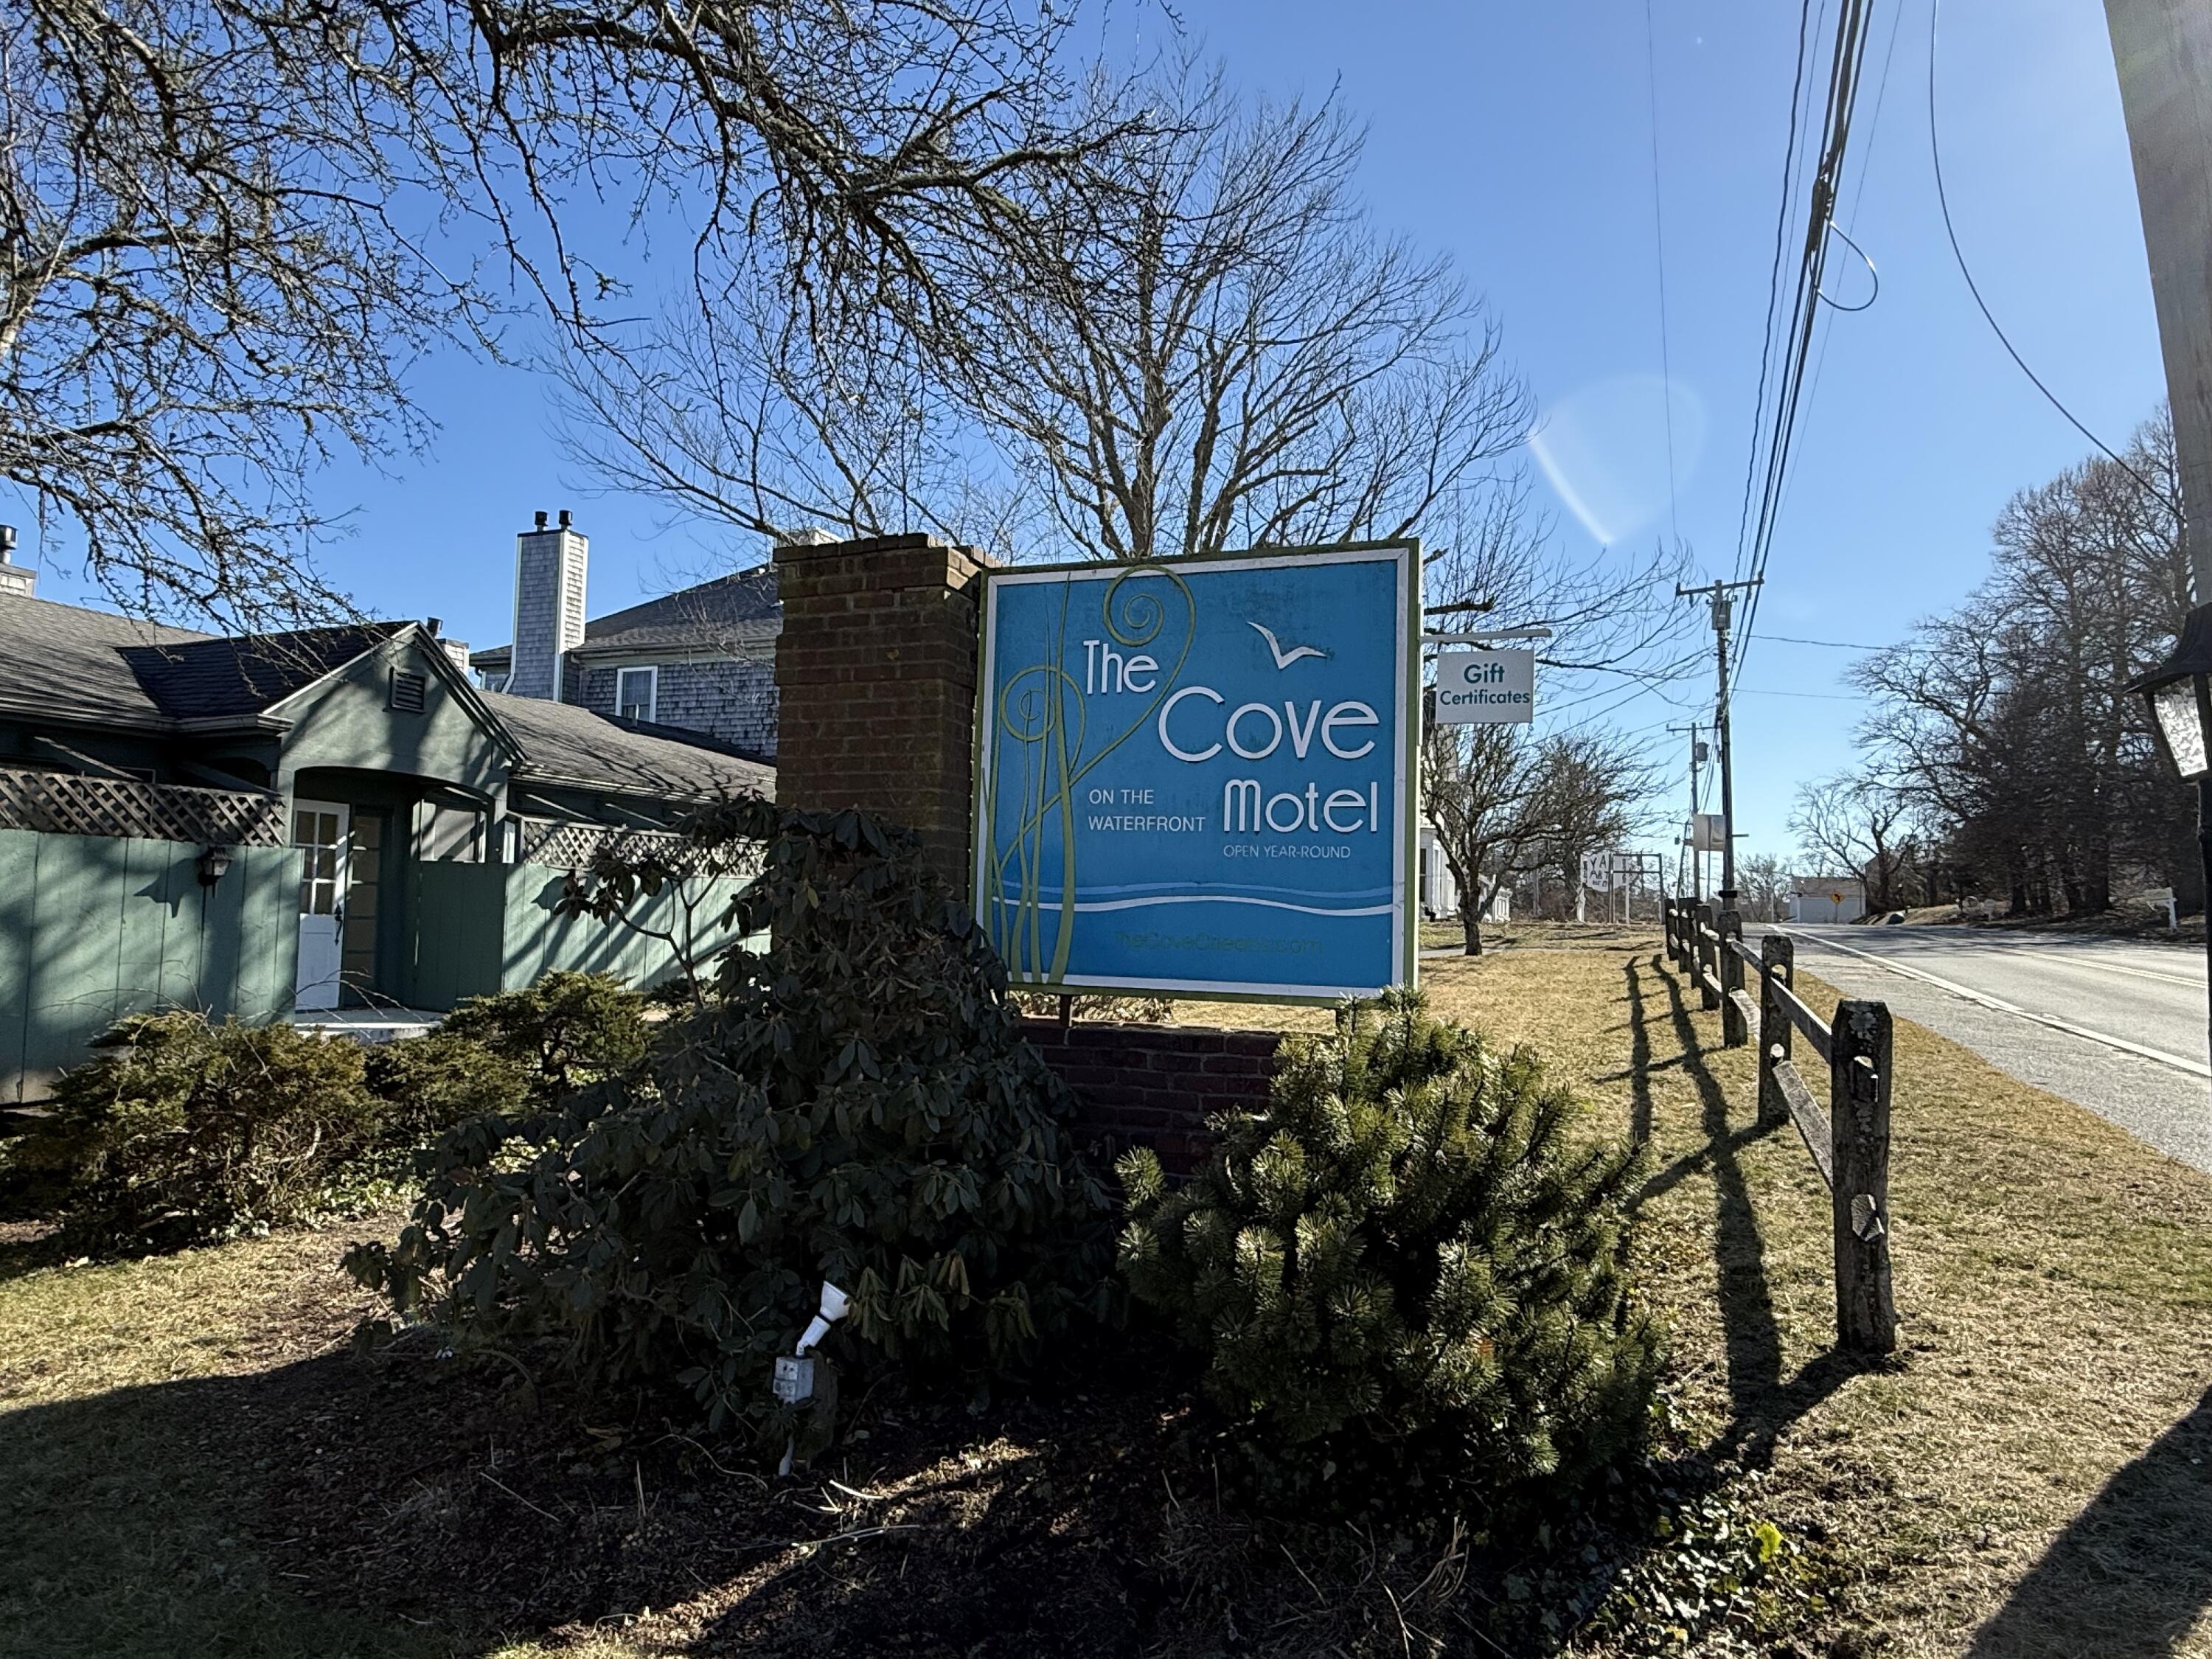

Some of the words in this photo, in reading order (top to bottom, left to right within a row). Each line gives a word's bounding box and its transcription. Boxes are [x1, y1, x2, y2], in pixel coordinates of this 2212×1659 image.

[1083, 639, 1159, 695] The
[1464, 663, 1505, 684] Gift
[1440, 689, 1531, 705] Certificates
[1158, 686, 1380, 762] Cove
[1088, 789, 1114, 804] ON
[1120, 789, 1154, 804] THE
[1223, 779, 1377, 833] Motel
[1088, 815, 1206, 832] WATERFRONT
[1223, 845, 1259, 858] OPEN
[1264, 845, 1351, 858] YEAR-ROUND
